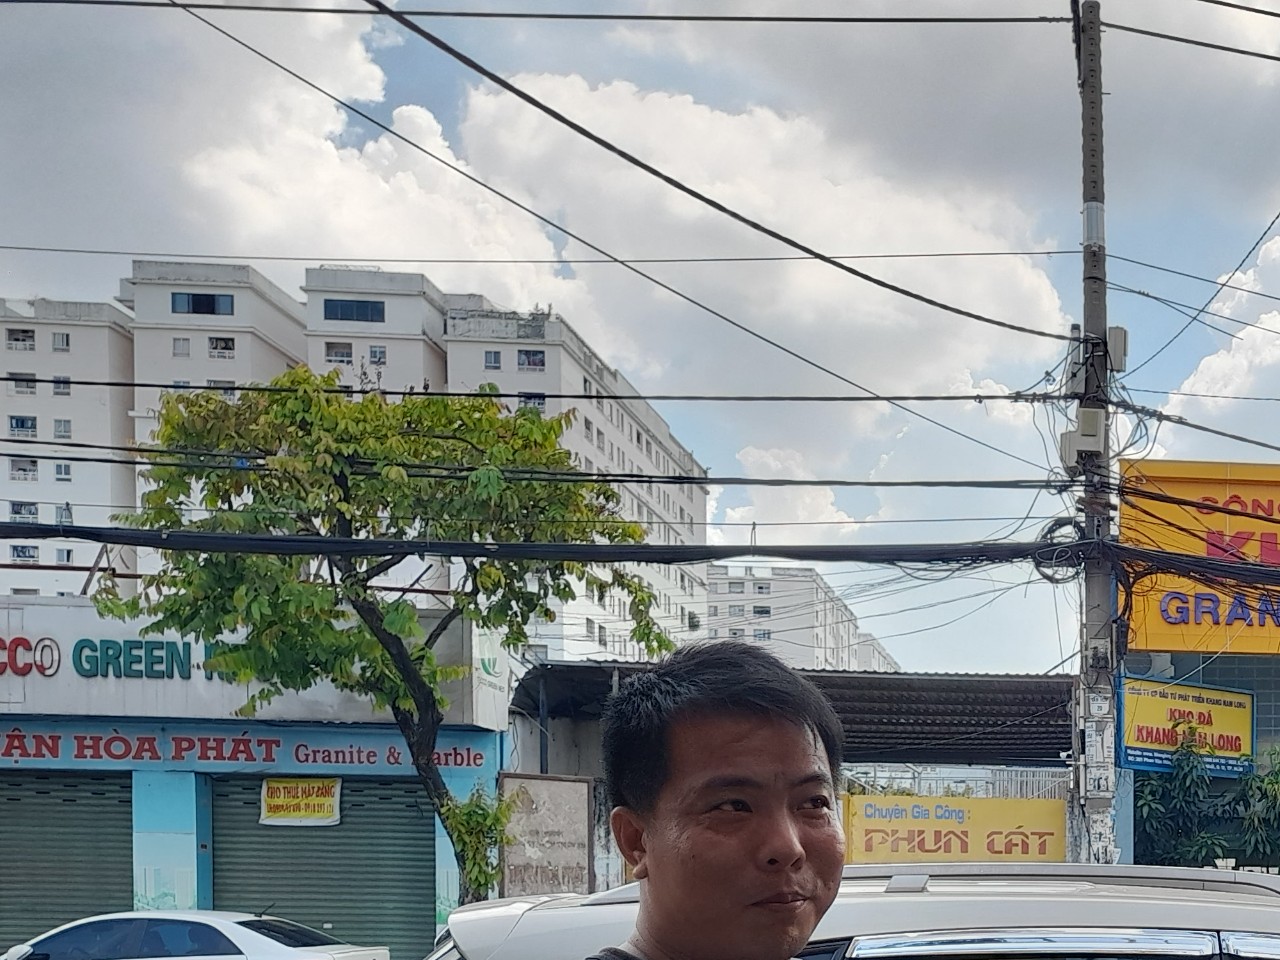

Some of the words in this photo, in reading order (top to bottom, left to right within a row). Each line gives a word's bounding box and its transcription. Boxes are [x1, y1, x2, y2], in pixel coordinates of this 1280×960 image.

[0, 637, 61, 678] CO
[72, 637, 192, 680] GREEN
[1168, 707, 1194, 724] KHO
[1197, 710, 1213, 726] ĐÁ
[73, 728, 161, 760] HÒA
[171, 731, 281, 762] PHÁT
[294, 744, 378, 765] Granite
[386, 746, 402, 765] &
[411, 747, 484, 767] arble
[1135, 724, 1178, 747] KHANG
[1182, 729, 1207, 749] NM
[1211, 733, 1242, 752] LONG
[864, 803, 907, 823] Chuyên
[911, 804, 930, 819] Gia
[864, 828, 969, 854] PHUN
[987, 825, 1055, 855] CÁT
